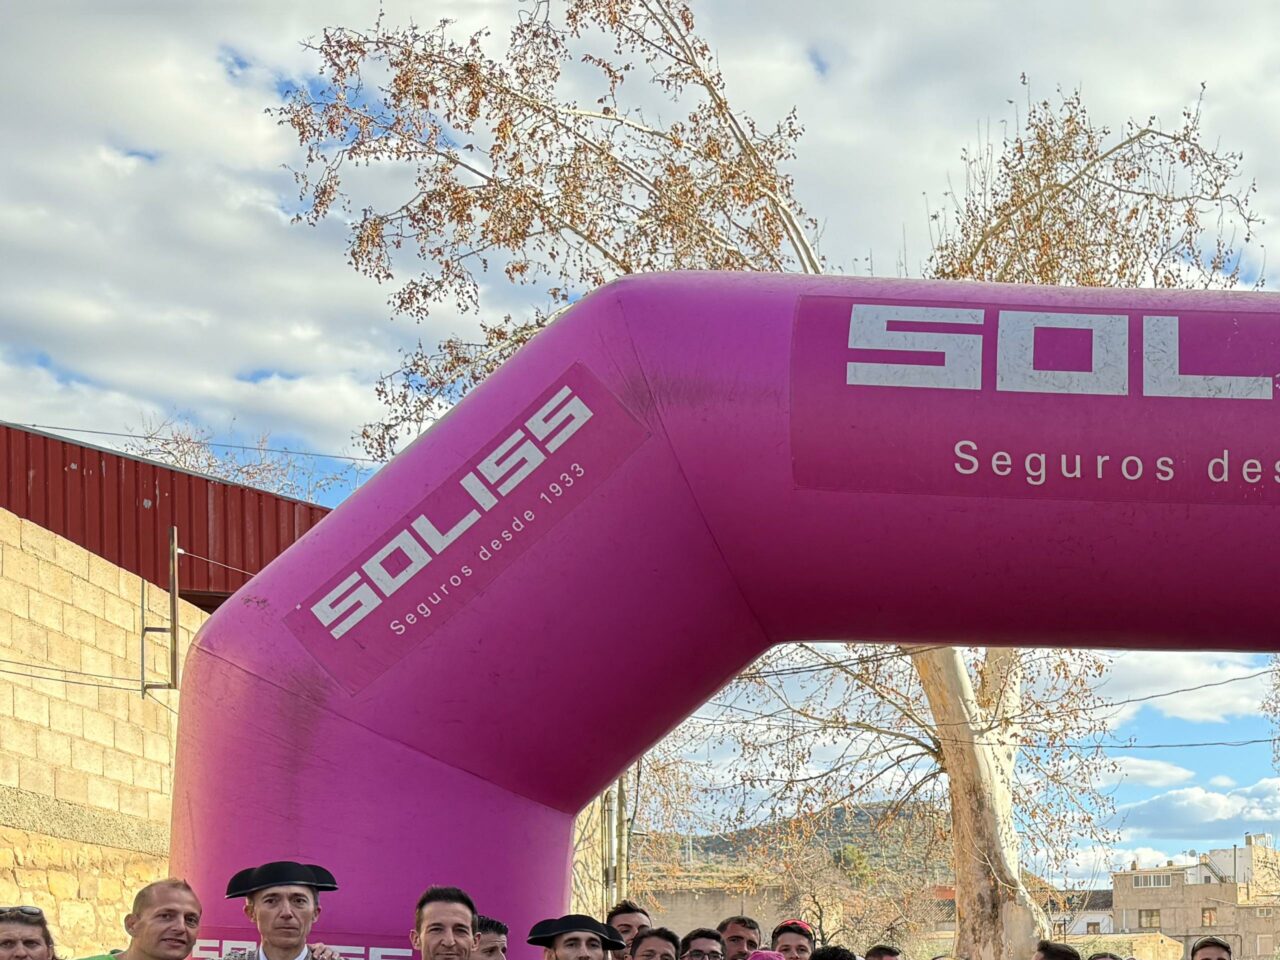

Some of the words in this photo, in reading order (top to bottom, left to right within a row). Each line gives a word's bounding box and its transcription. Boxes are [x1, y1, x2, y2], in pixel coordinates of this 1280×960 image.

[310, 385, 594, 640] SOLISS
[389, 564, 473, 635] Seguros
[478, 508, 535, 561] desde
[539, 462, 585, 505] 1933
[954, 440, 1175, 486] Seguros
